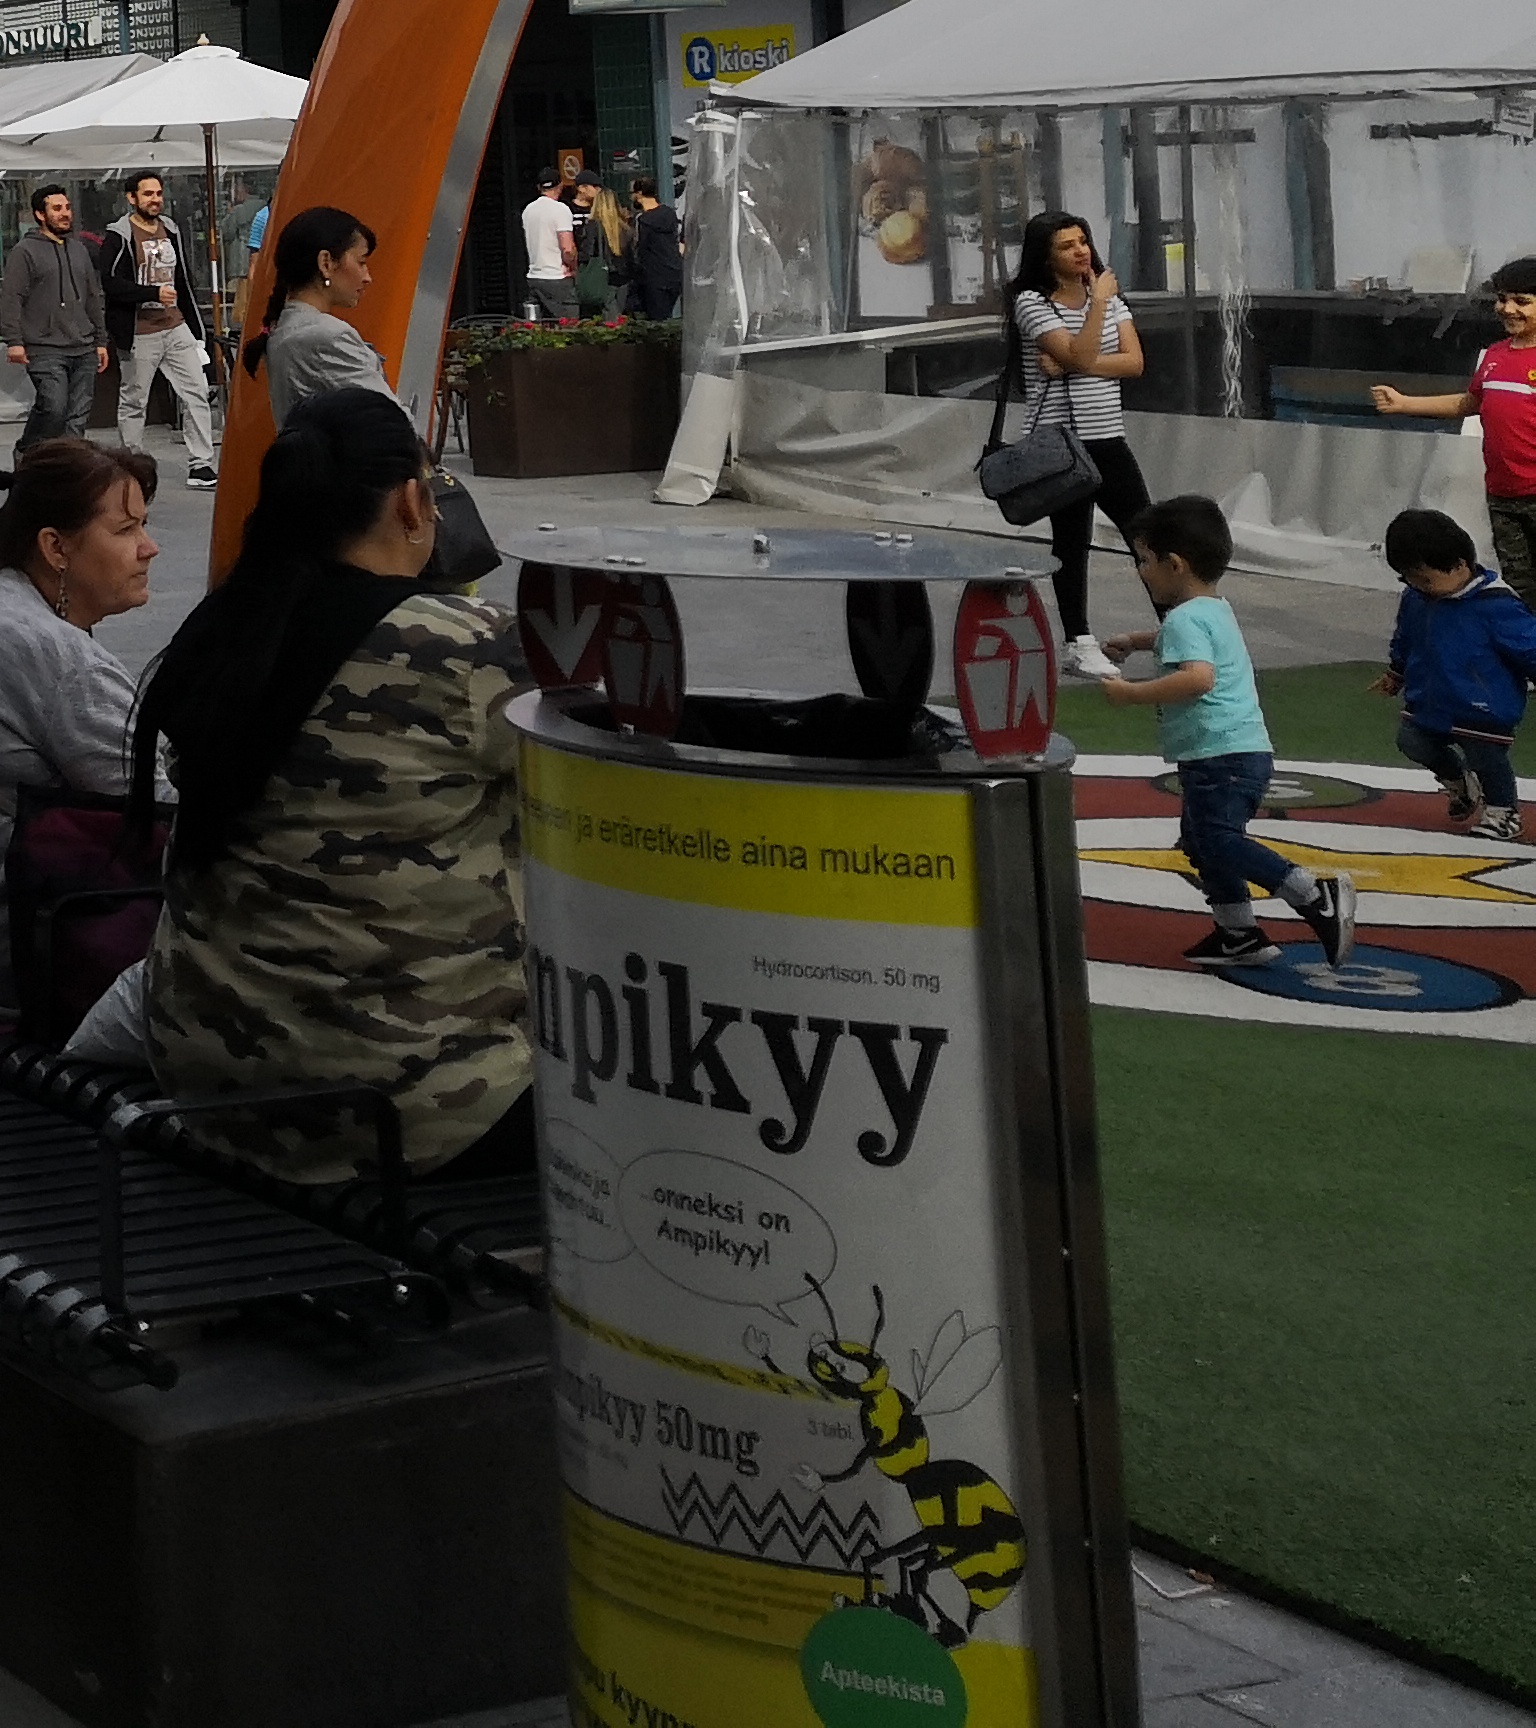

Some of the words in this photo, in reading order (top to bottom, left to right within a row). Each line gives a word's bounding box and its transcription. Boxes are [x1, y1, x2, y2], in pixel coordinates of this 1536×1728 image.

[718, 38, 790, 72] kioski
[598, 813, 731, 863] eräretkelle
[740, 835, 808, 872] aina
[819, 843, 957, 881] mukaan
[883, 968, 906, 988] 50
[912, 973, 941, 994] mg
[757, 1210, 792, 1234] on
[819, 1660, 947, 1707] Apteekista
